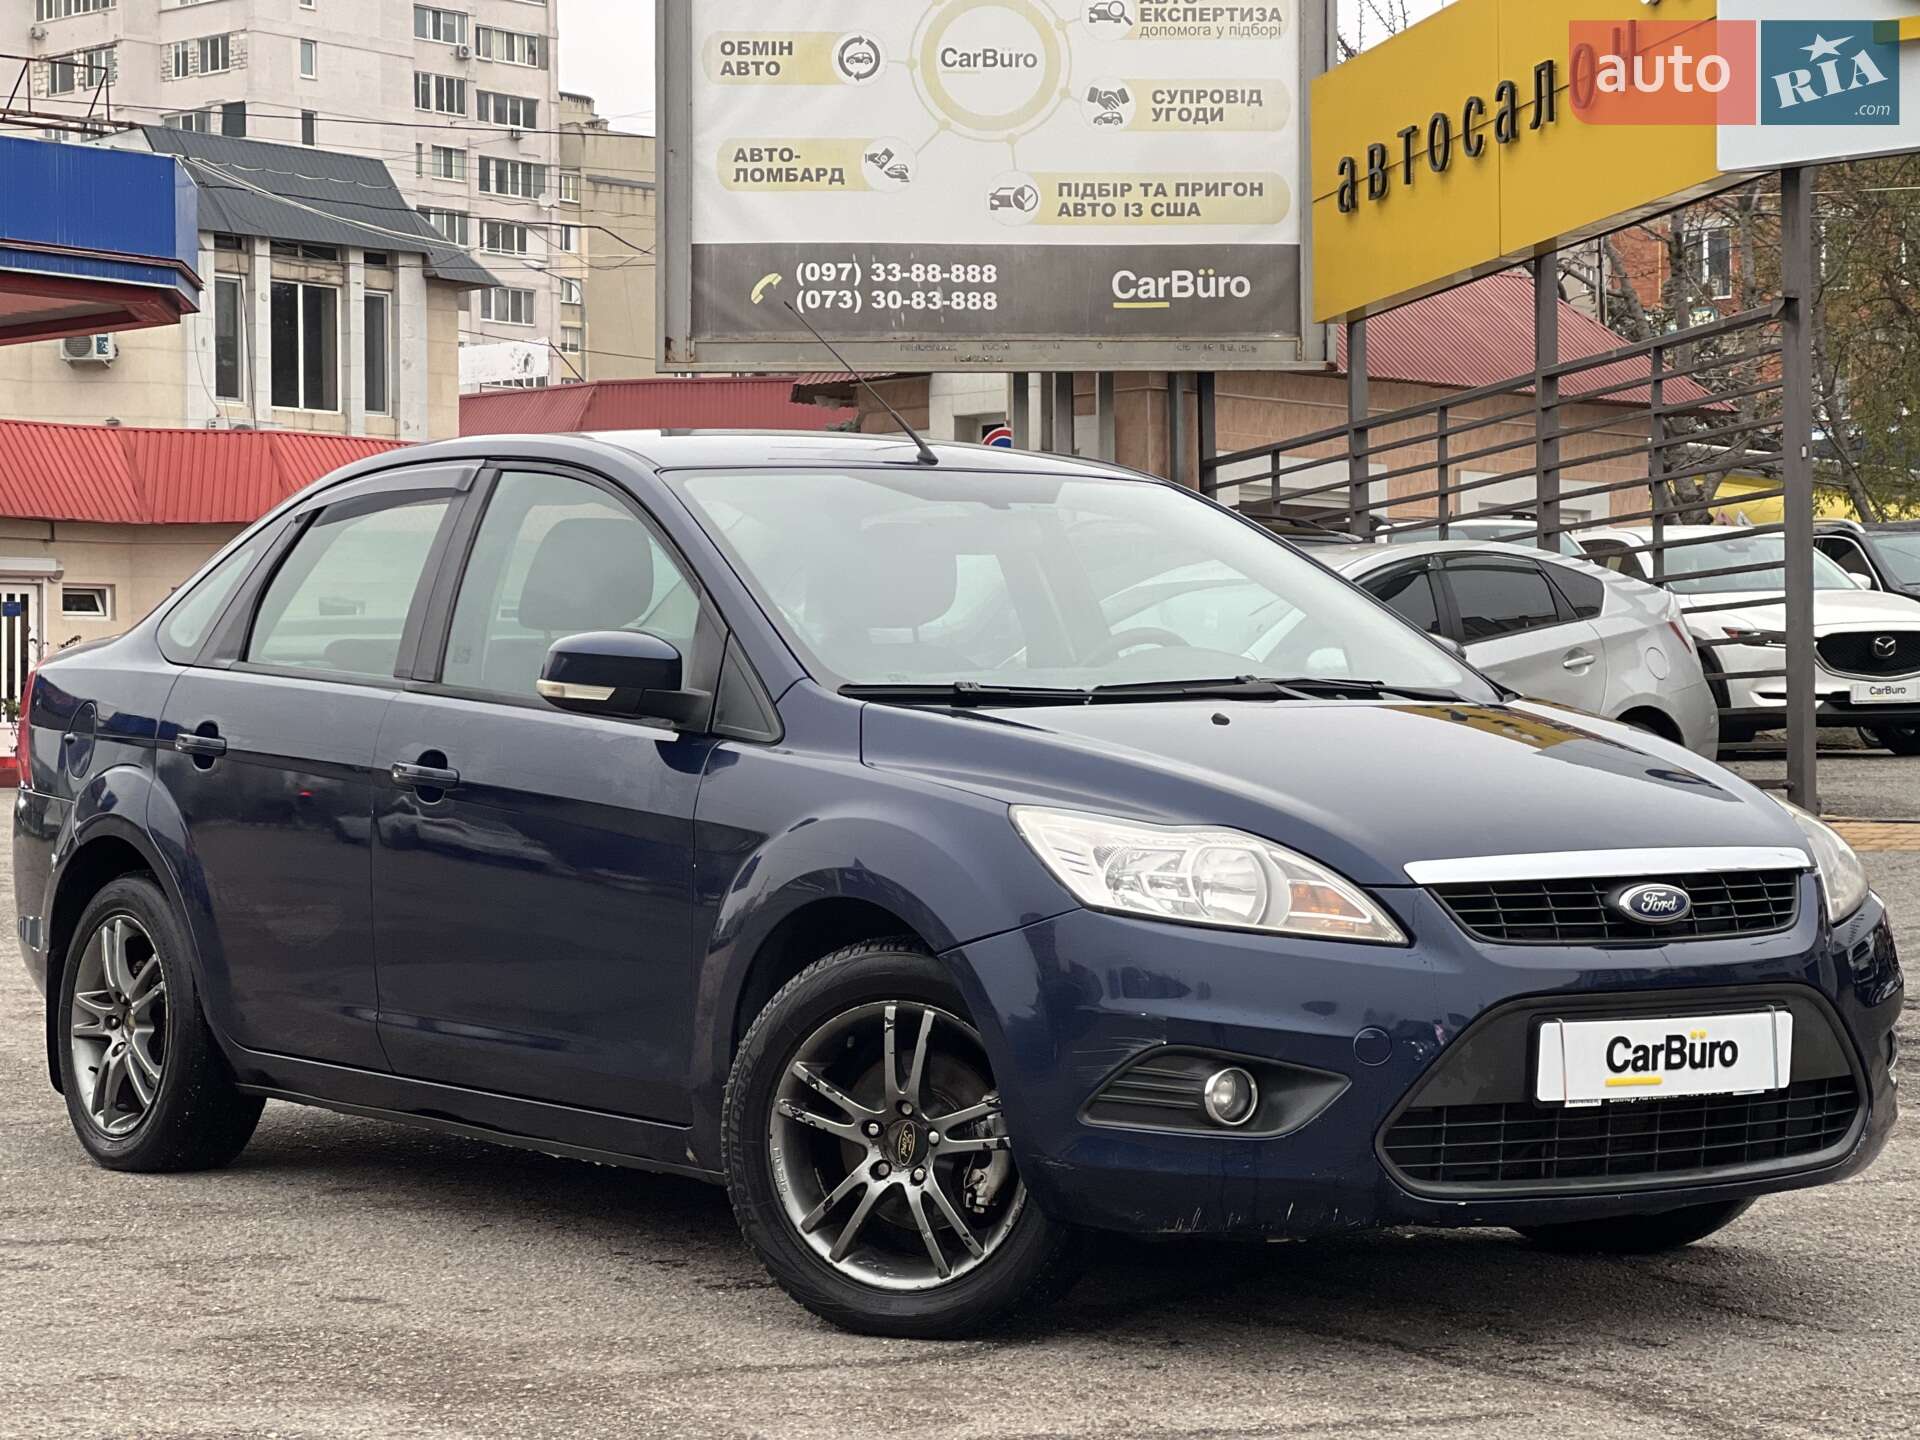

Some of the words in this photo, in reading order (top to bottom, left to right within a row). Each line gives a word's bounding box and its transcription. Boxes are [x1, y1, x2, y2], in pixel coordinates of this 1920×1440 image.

[1139, 7, 1282, 22] ЕКСПЕРТИЗА
[1139, 24, 1211, 38] допомога
[1216, 25, 1224, 39] у
[1229, 22, 1281, 39] підборі
[720, 40, 793, 56] ОБМІН
[720, 60, 781, 76] АВТО
[1151, 89, 1263, 107] СУПРОВІД
[1151, 107, 1224, 125] УГОДИ
[733, 148, 801, 163] АВТО-
[733, 167, 845, 185] ЛОМБАРД
[1057, 182, 1132, 200] ПІДБІР
[1139, 182, 1168, 197] ТА
[1175, 182, 1264, 197] ПРИГОН
[1057, 202, 1117, 217] АВТО
[1124, 202, 1143, 217] ІЗ
[1150, 202, 1201, 217] США
[796, 262, 862, 286] (097)
[870, 263, 998, 283] 33-88-888
[1111, 268, 1251, 299] CarBüro
[796, 290, 862, 313] (073)
[871, 290, 998, 310] 30-83-888
[1641, 891, 1678, 912] Ford
[1605, 1030, 1739, 1073] CarBüro
[900, 1130, 913, 1157] Ford
